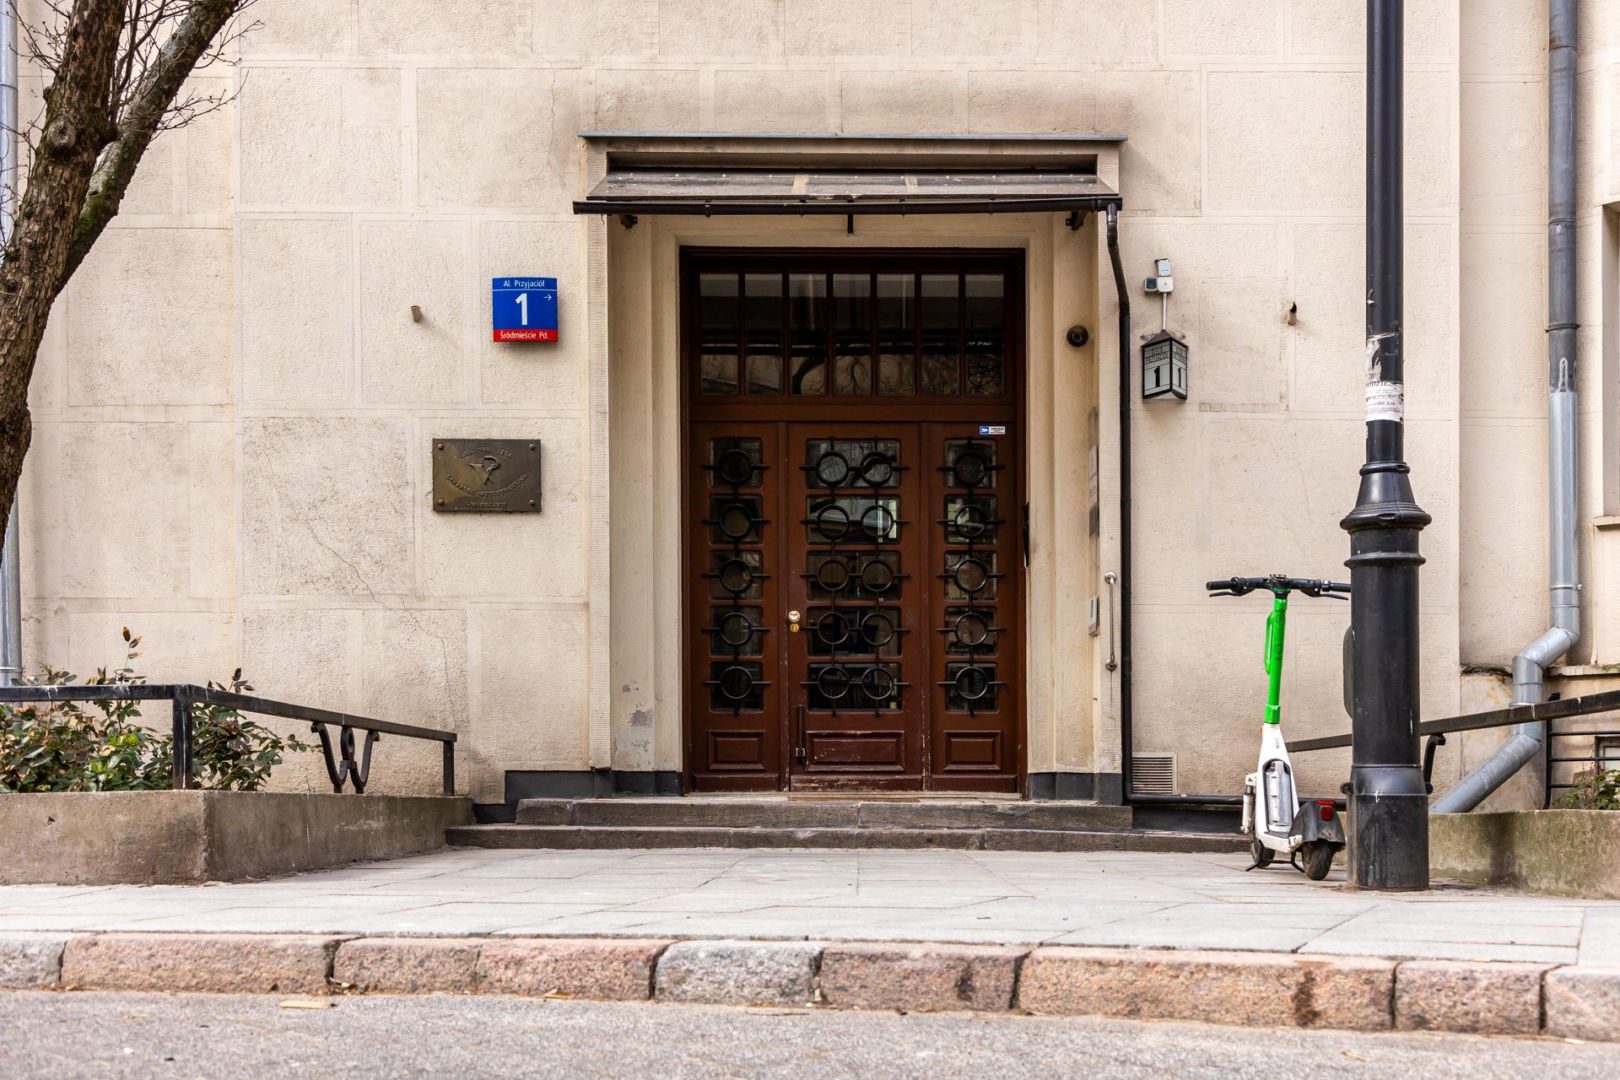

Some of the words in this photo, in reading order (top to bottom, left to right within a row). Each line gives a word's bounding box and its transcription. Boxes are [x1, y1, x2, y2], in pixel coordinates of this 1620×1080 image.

[503, 280, 511, 288] Al.
[514, 280, 545, 289] Przyjaciół
[514, 292, 528, 326] 1
[500, 330, 536, 340] Śródmieście
[539, 331, 550, 340] Pd.
[1154, 366, 1160, 388] 1
[1178, 366, 1182, 388] 1
